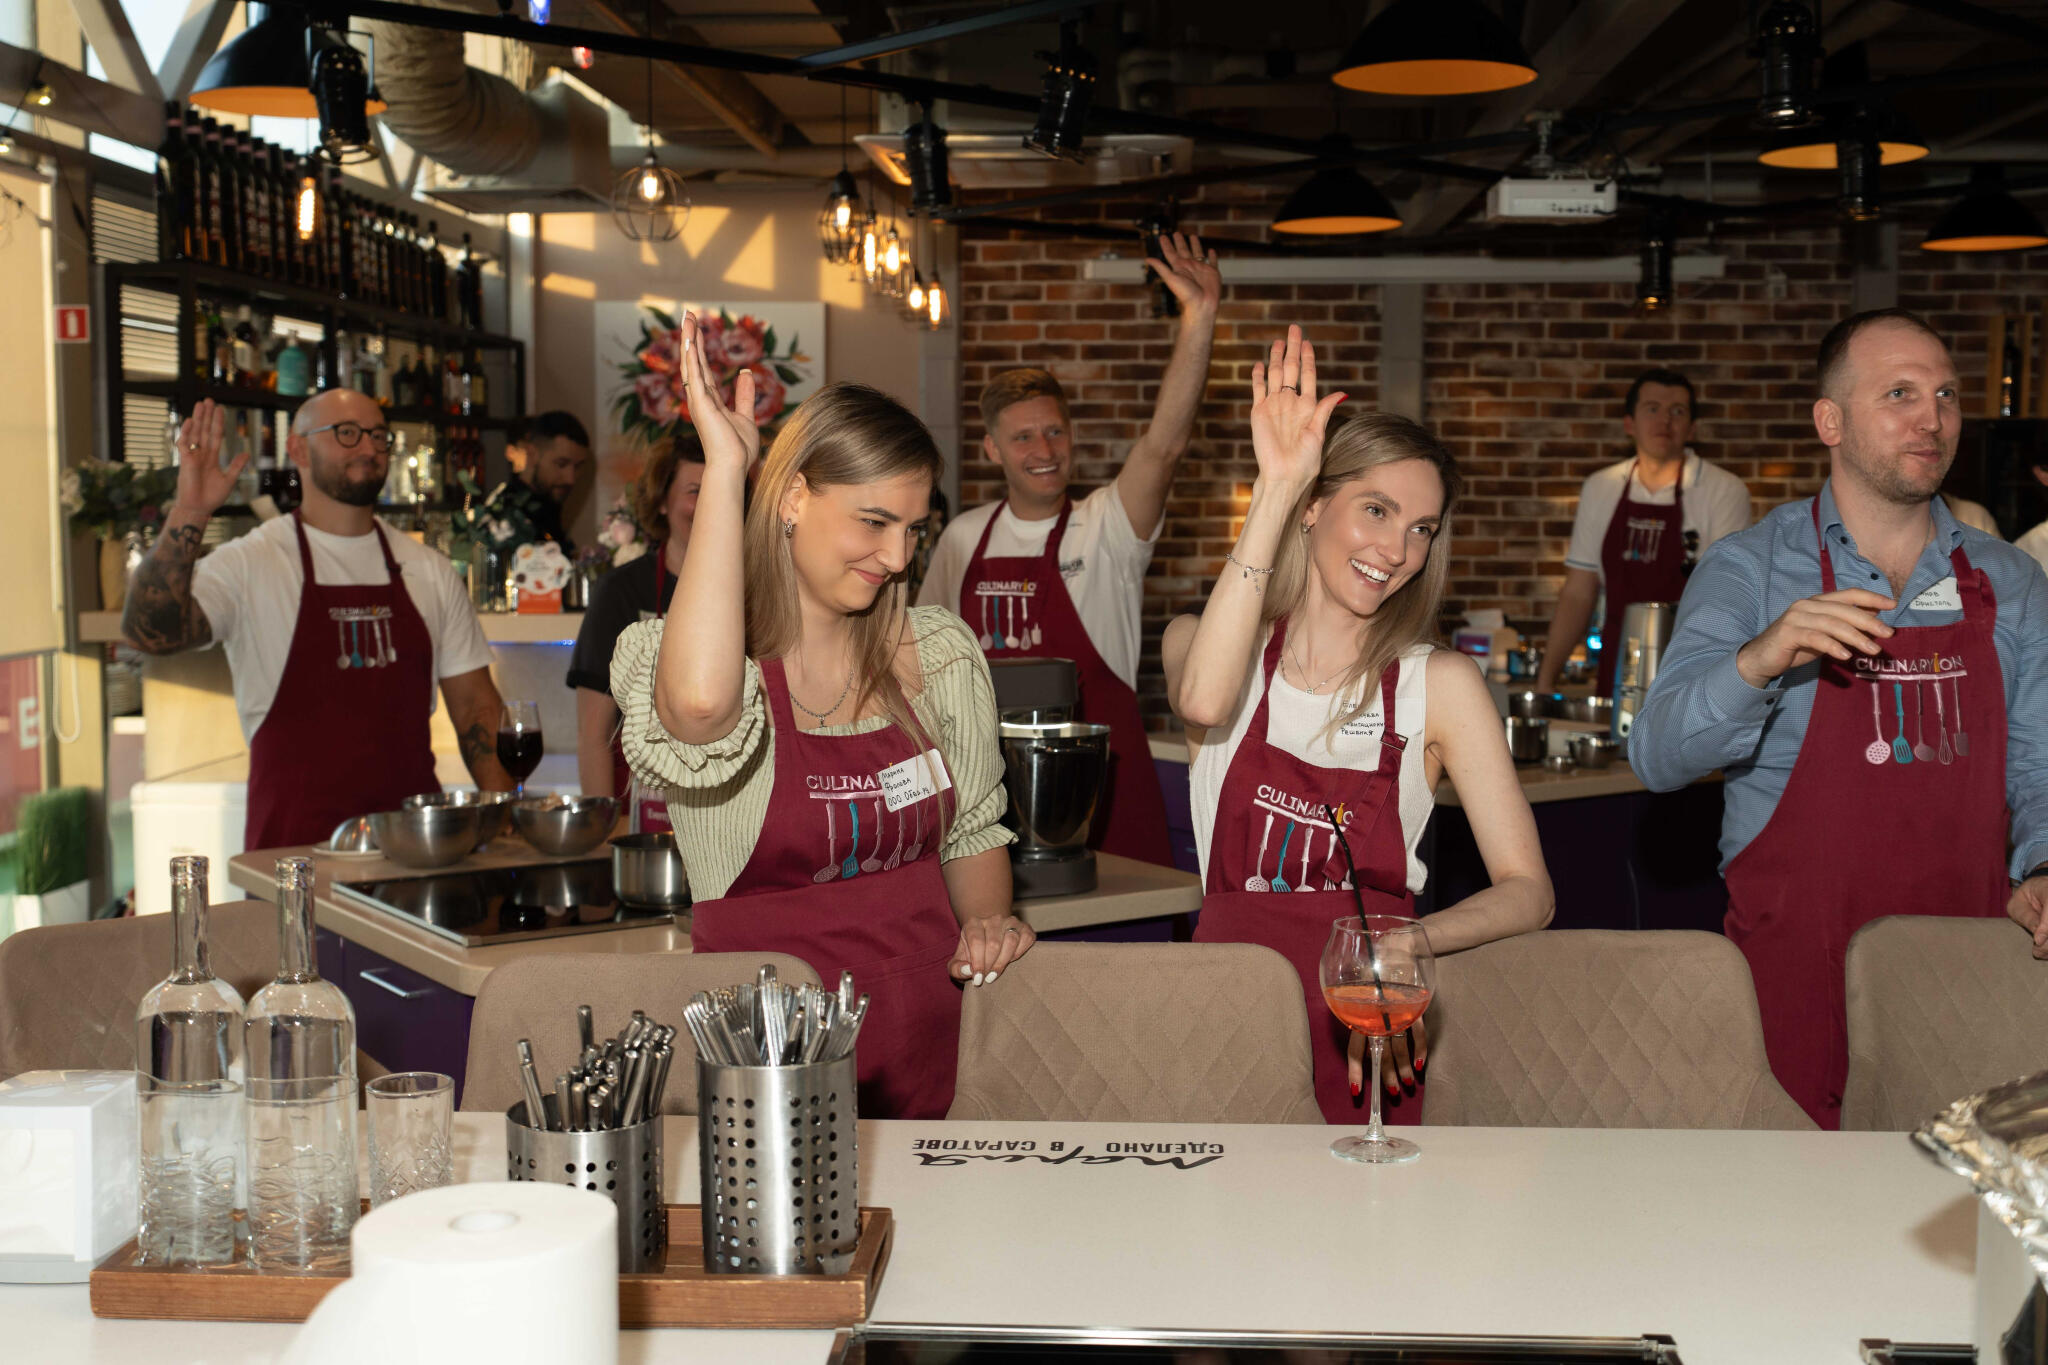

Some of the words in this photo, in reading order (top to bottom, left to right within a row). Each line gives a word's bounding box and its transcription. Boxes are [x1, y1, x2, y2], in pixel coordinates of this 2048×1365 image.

[912, 1138, 1037, 1151] САРАТОВЕ
[1051, 1140, 1065, 1151] В
[1106, 1141, 1225, 1154] СДЕЛАНО
